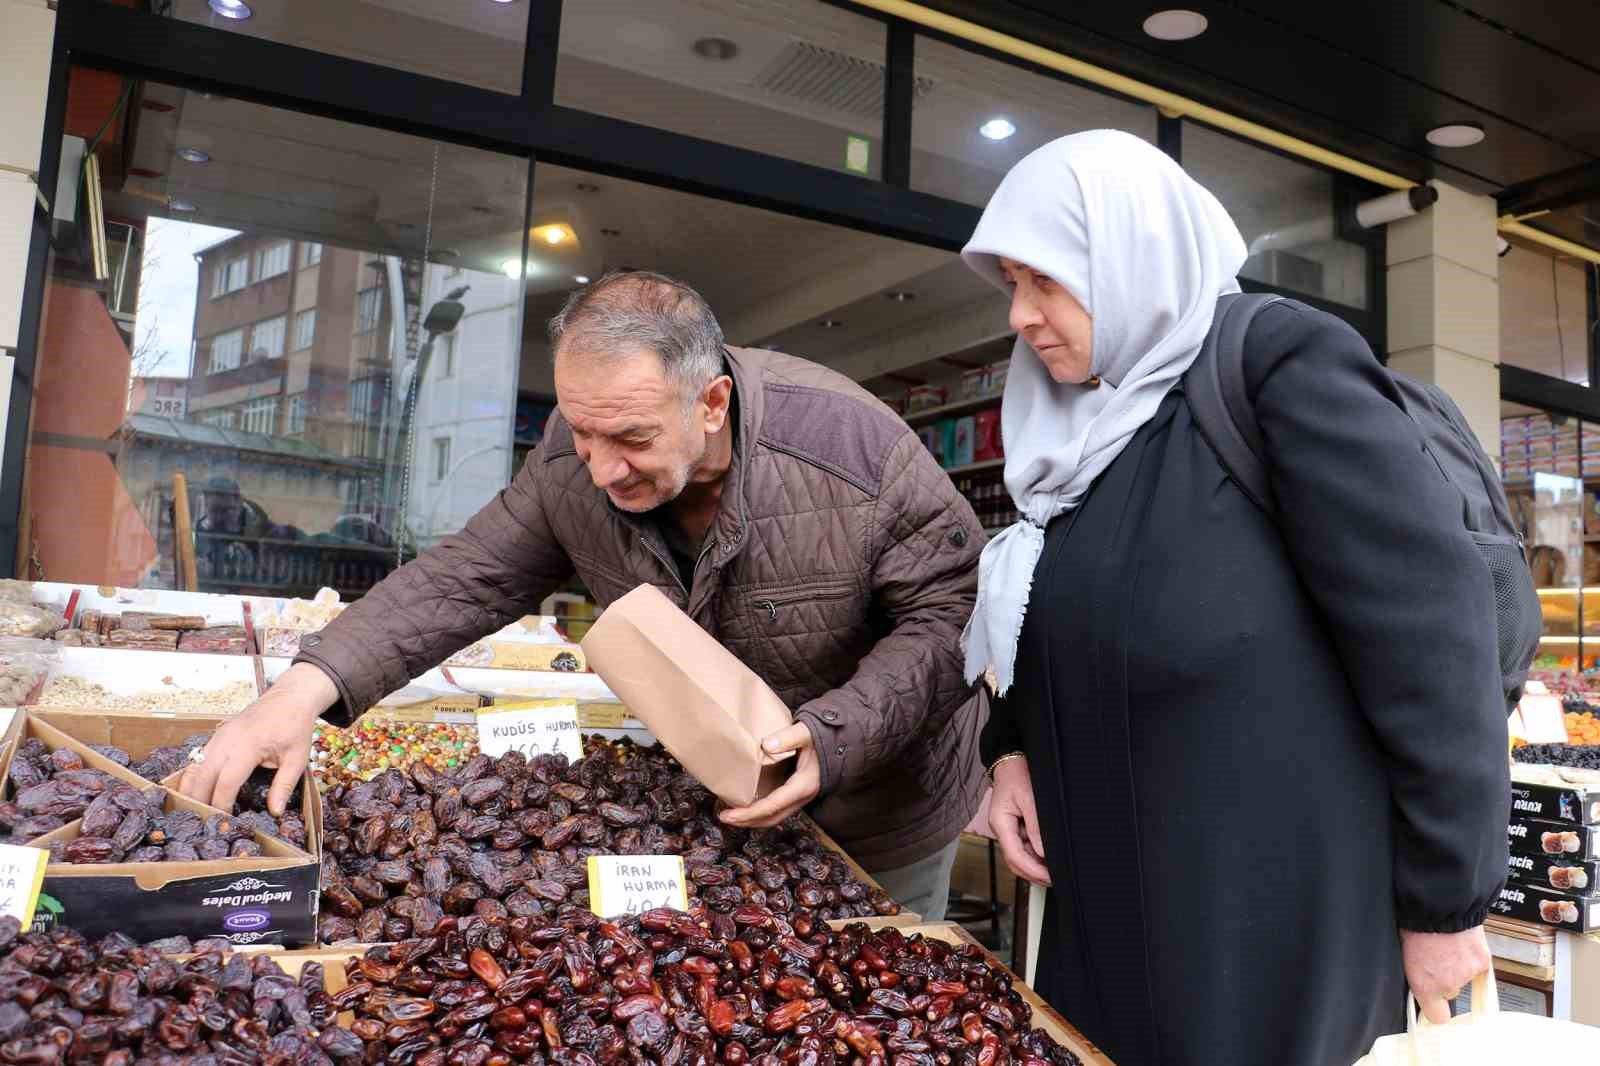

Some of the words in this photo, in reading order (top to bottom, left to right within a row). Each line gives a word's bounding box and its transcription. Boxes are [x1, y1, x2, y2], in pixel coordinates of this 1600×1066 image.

[492, 720, 536, 738] KUDÜS
[1514, 799, 1542, 813] KURU
[616, 861, 652, 877] İRAN
[624, 879, 678, 892] HURMA
[202, 895, 242, 908] Dates
[241, 890, 292, 906] Medjoul
